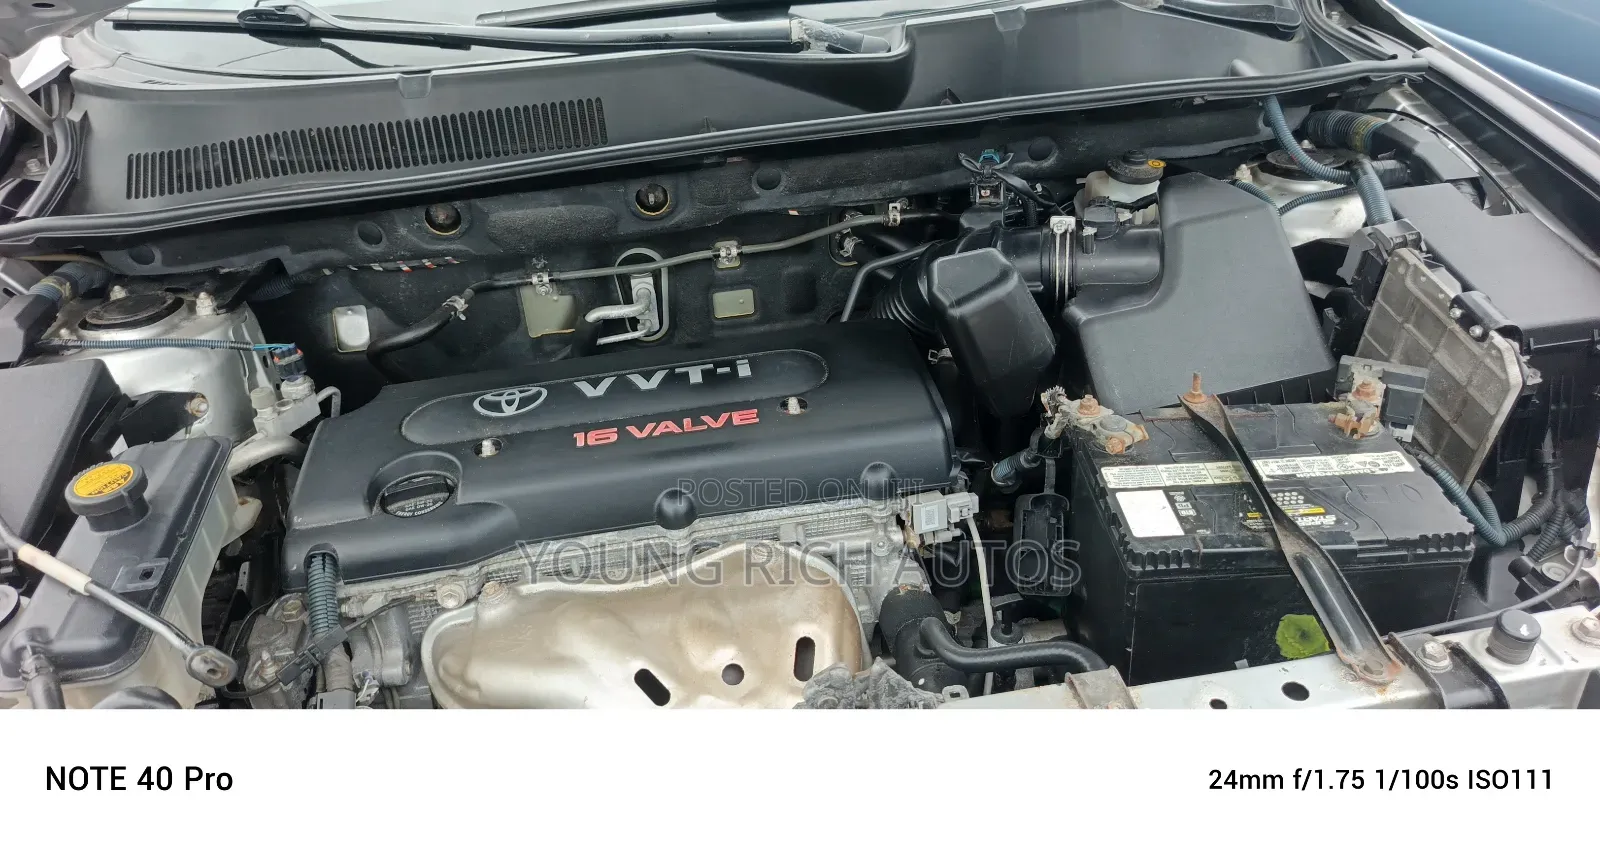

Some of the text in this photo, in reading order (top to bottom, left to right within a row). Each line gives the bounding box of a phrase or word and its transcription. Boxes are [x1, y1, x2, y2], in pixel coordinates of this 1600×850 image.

[573, 359, 752, 398] VVT-i
[573, 408, 759, 447] 16 VALVE
